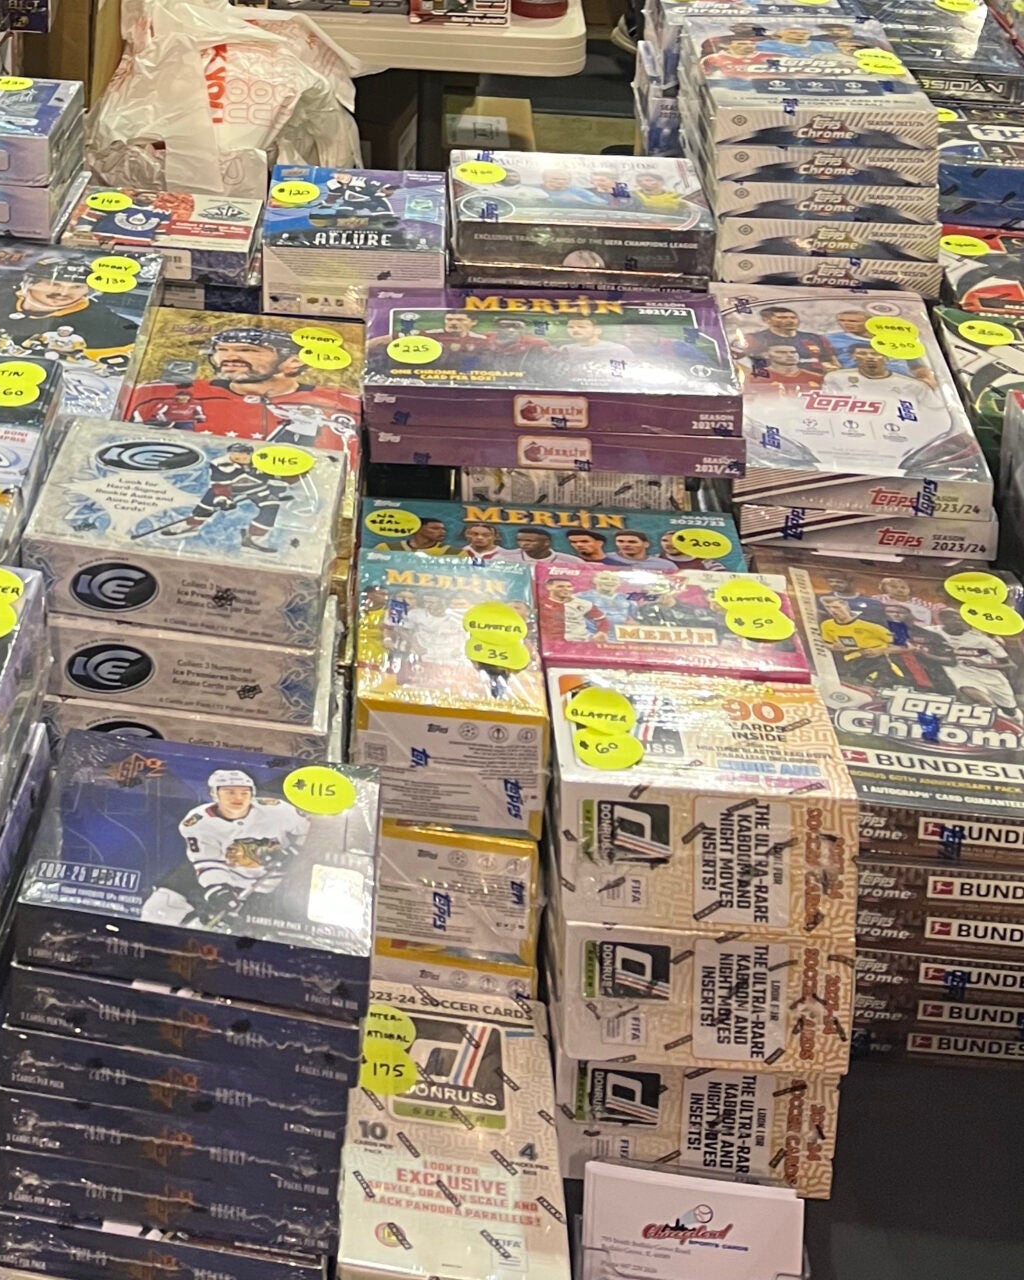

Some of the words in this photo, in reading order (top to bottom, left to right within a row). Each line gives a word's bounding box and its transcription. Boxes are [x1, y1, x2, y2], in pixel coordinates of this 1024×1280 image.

[923, 80, 1004, 93] BSIDIAN
[798, 200, 855, 213] Chrome
[314, 231, 392, 246] ALLURE
[804, 238, 858, 250] Chrome
[98, 263, 132, 272] HOBBY
[95, 276, 126, 284] $130
[802, 275, 860, 287] Chrome
[465, 295, 624, 316] MERLIN
[875, 324, 911, 334] HOBBY
[300, 334, 339, 343] HOBBY
[876, 340, 916, 350] $300
[393, 342, 430, 353] $225
[305, 349, 341, 362] $120
[0, 369, 24, 377] TIN
[802, 390, 886, 415] Topps
[699, 414, 734, 422] SEASON
[257, 452, 297, 466] $145
[106, 483, 167, 495] Hard-Signed
[105, 496, 129, 504] Auto
[132, 500, 158, 508] Patch
[113, 504, 147, 513] Cards!
[464, 505, 626, 530] MERLIN
[677, 535, 721, 549] $200
[877, 528, 924, 549] Topps
[932, 534, 965, 542] SEASON
[931, 542, 987, 553] 2023/24
[956, 585, 998, 596] HOBBY
[722, 594, 776, 605] BLASTER
[967, 608, 1004, 622] $80
[468, 621, 522, 633] BLASTER
[735, 617, 773, 628] $50
[618, 627, 715, 644] MERLIN
[474, 644, 509, 660] $35
[720, 700, 784, 723] 90
[879, 687, 993, 725] Topps
[571, 708, 626, 722] BLASTER
[731, 731, 786, 743] INSIDE
[579, 740, 618, 754] $60
[293, 778, 336, 797] $115
[755, 803, 770, 829] THE
[719, 812, 734, 862] NIGHT
[701, 826, 717, 891] INSERTS!
[754, 835, 770, 923] ULTRA-RARE
[719, 865, 734, 909] MOVES
[754, 945, 769, 969] THE
[700, 965, 716, 1027] INSERTS!
[421, 995, 479, 1013] SOCCER
[751, 974, 768, 1059] ULTRA-RARE
[367, 1029, 410, 1043] ATIONAL
[630, 1017, 641, 1041] FIFA
[706, 1081, 723, 1126] NIGHT
[358, 1120, 388, 1141] 10
[519, 1143, 538, 1161] 4
[719, 1138, 734, 1168] AND
[423, 1161, 452, 1173] LOOK
[456, 1164, 479, 1175] FOR
[396, 1168, 507, 1196] EXCLUSIVE
[406, 1199, 461, 1217] PANDORA
[469, 1196, 510, 1208] SCALE
[513, 1200, 538, 1212] AND
